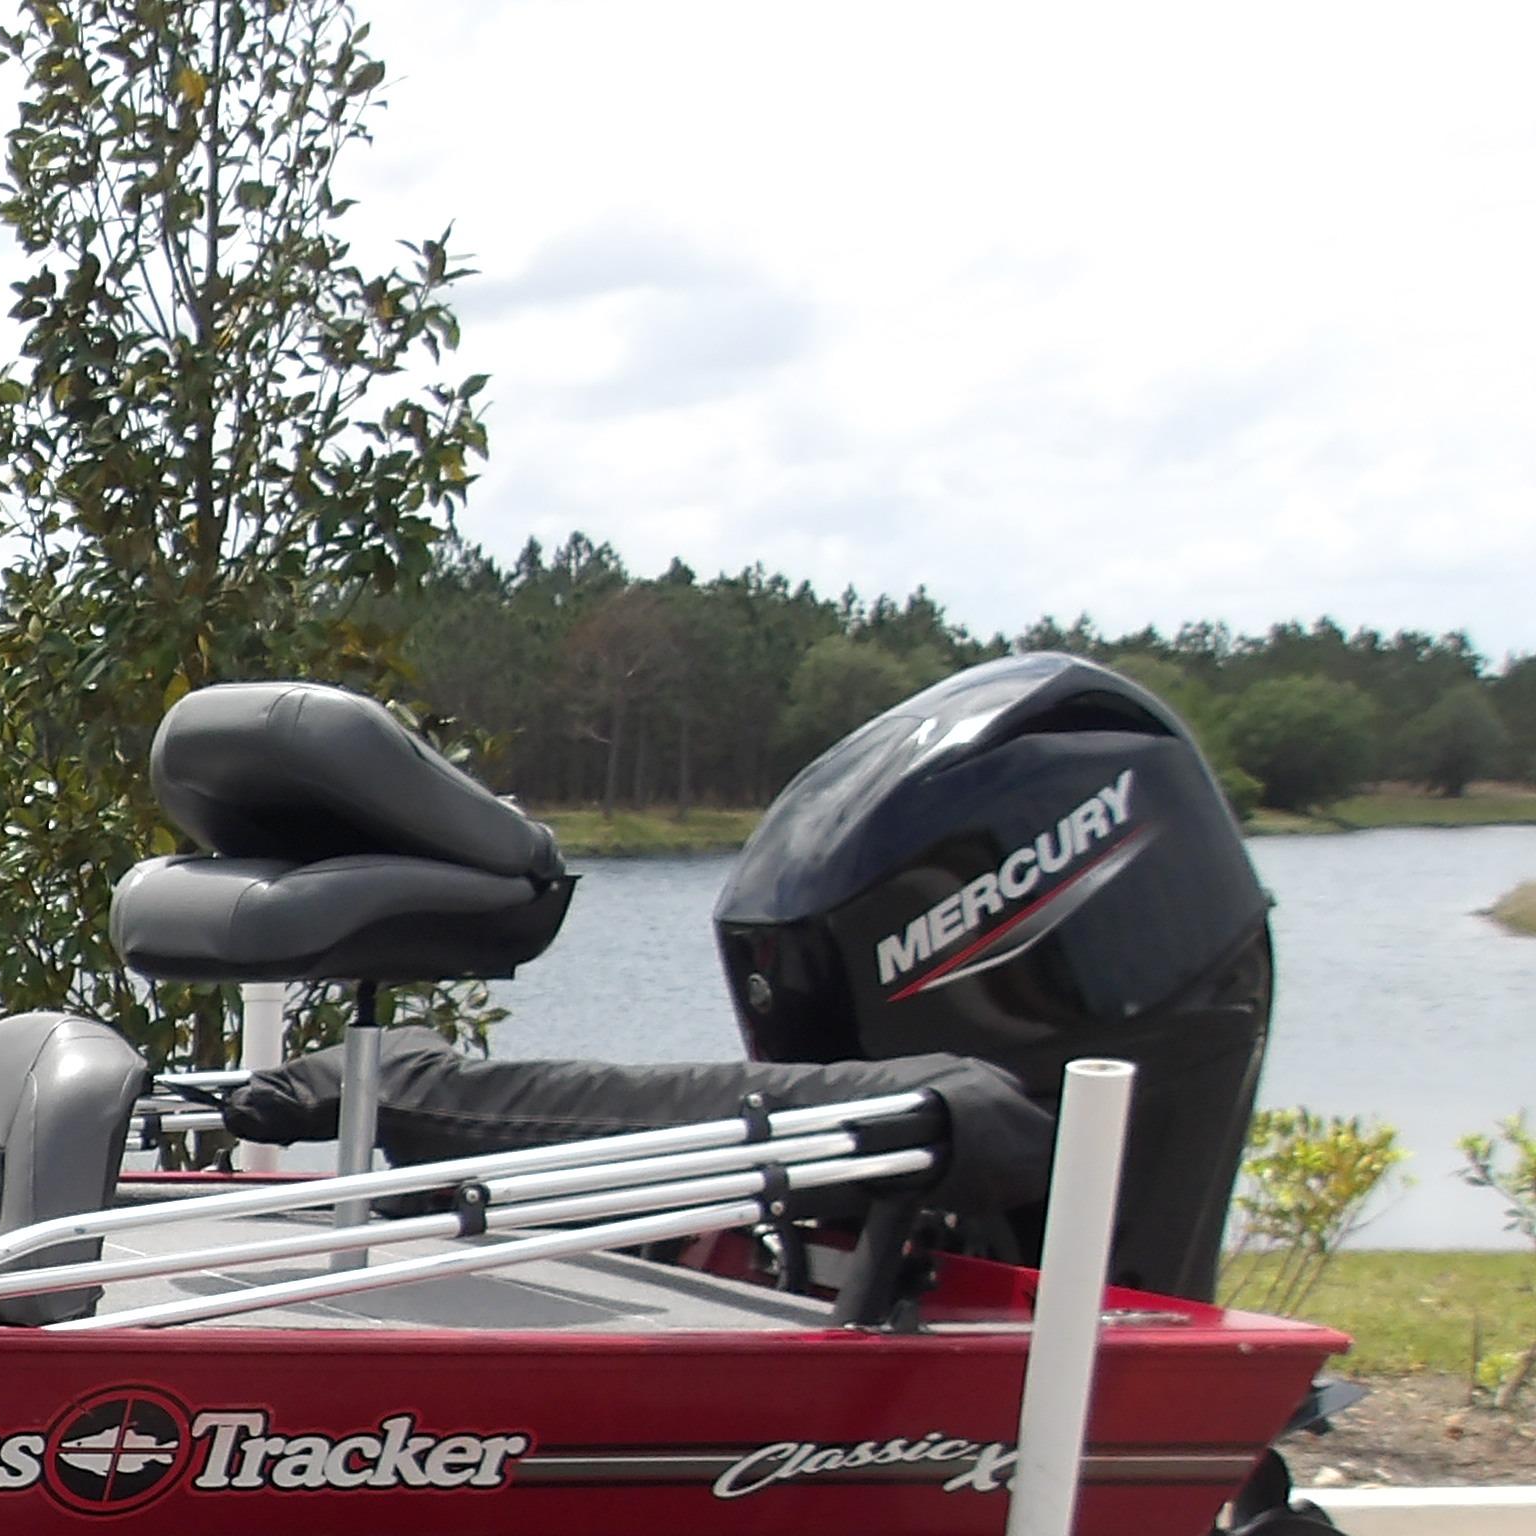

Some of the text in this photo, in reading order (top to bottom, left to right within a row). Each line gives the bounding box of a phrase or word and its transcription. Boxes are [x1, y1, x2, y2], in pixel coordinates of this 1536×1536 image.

[877, 769, 1134, 985] MERCURY
[190, 1410, 528, 1490] Tracker
[712, 1432, 1021, 1498] Classic X
